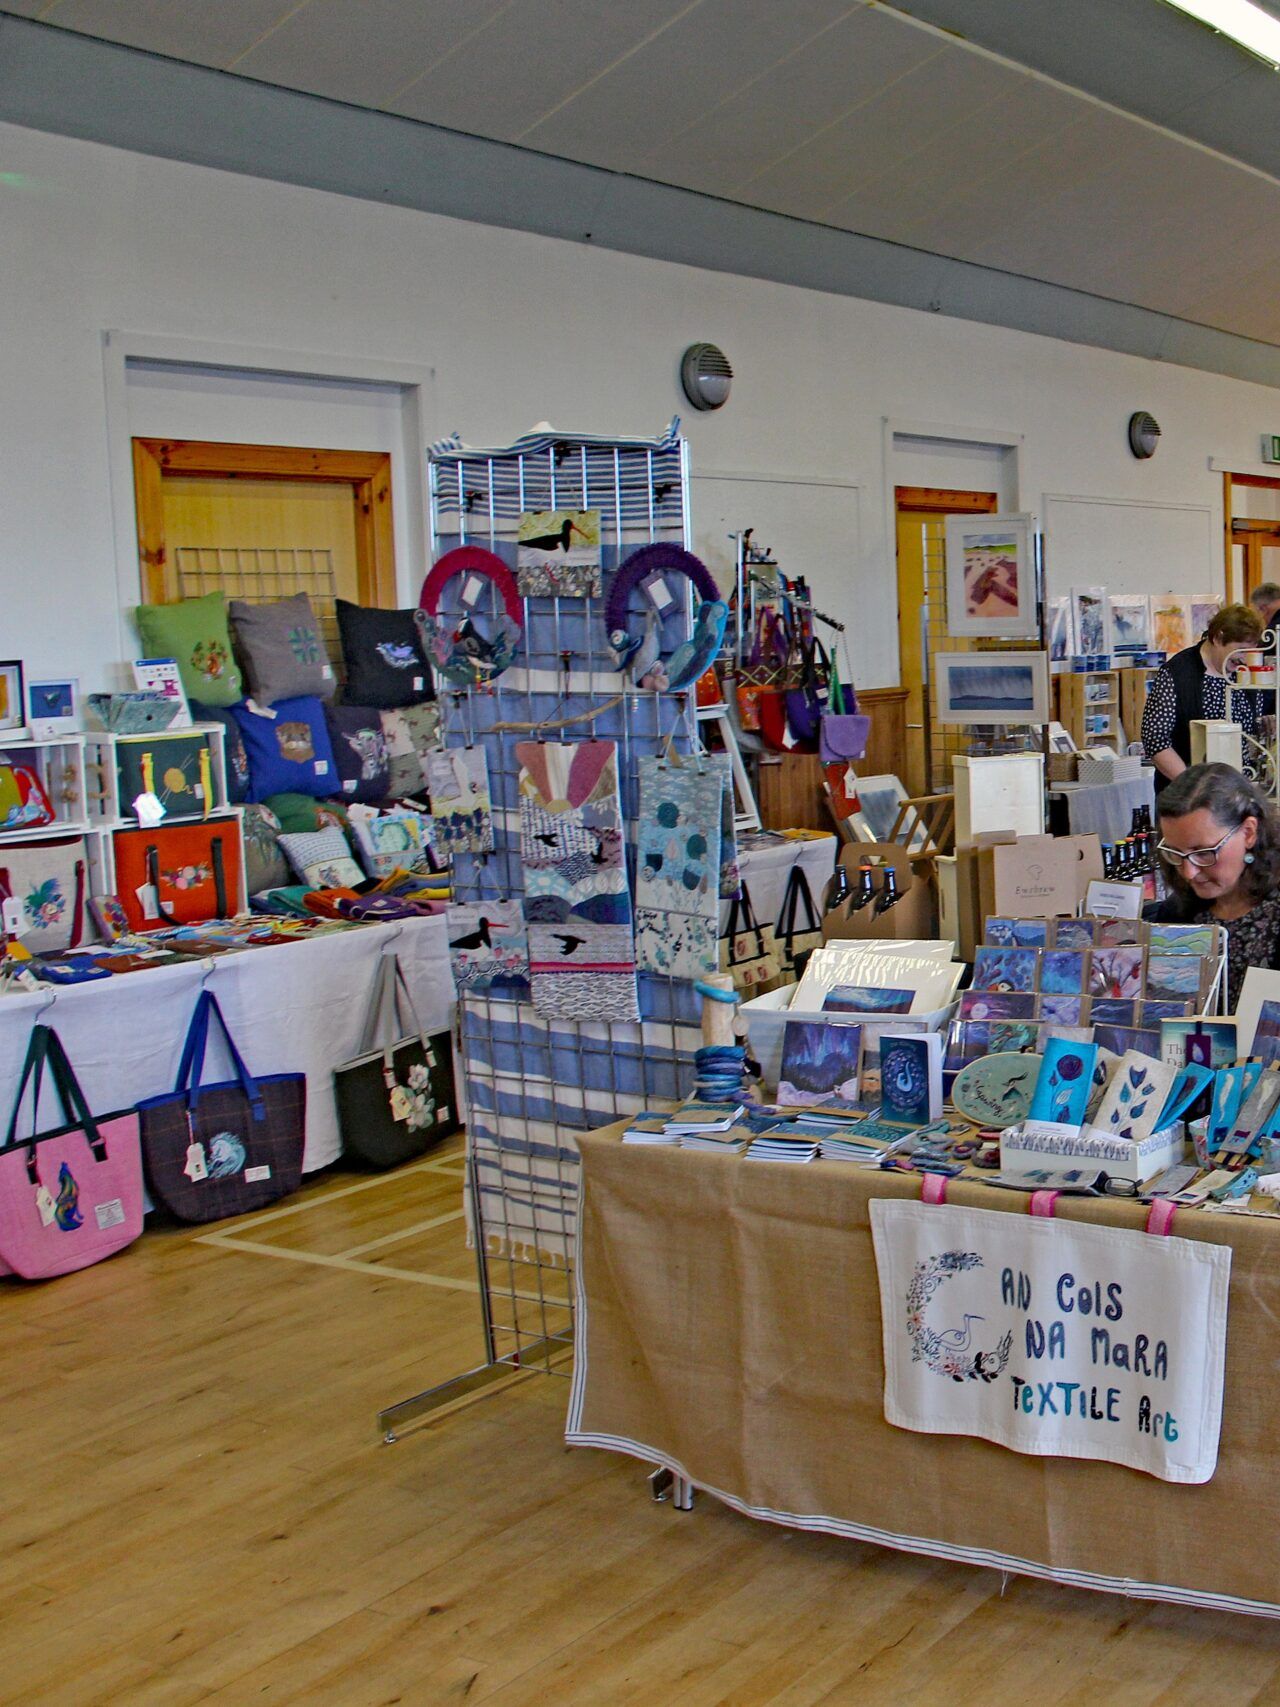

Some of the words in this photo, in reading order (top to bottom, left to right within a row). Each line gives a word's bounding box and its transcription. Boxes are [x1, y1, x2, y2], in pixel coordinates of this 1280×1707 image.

[1001, 1267, 1032, 1312] AN
[1025, 1319, 1066, 1360] NA
[1138, 1395, 1179, 1442] Art
